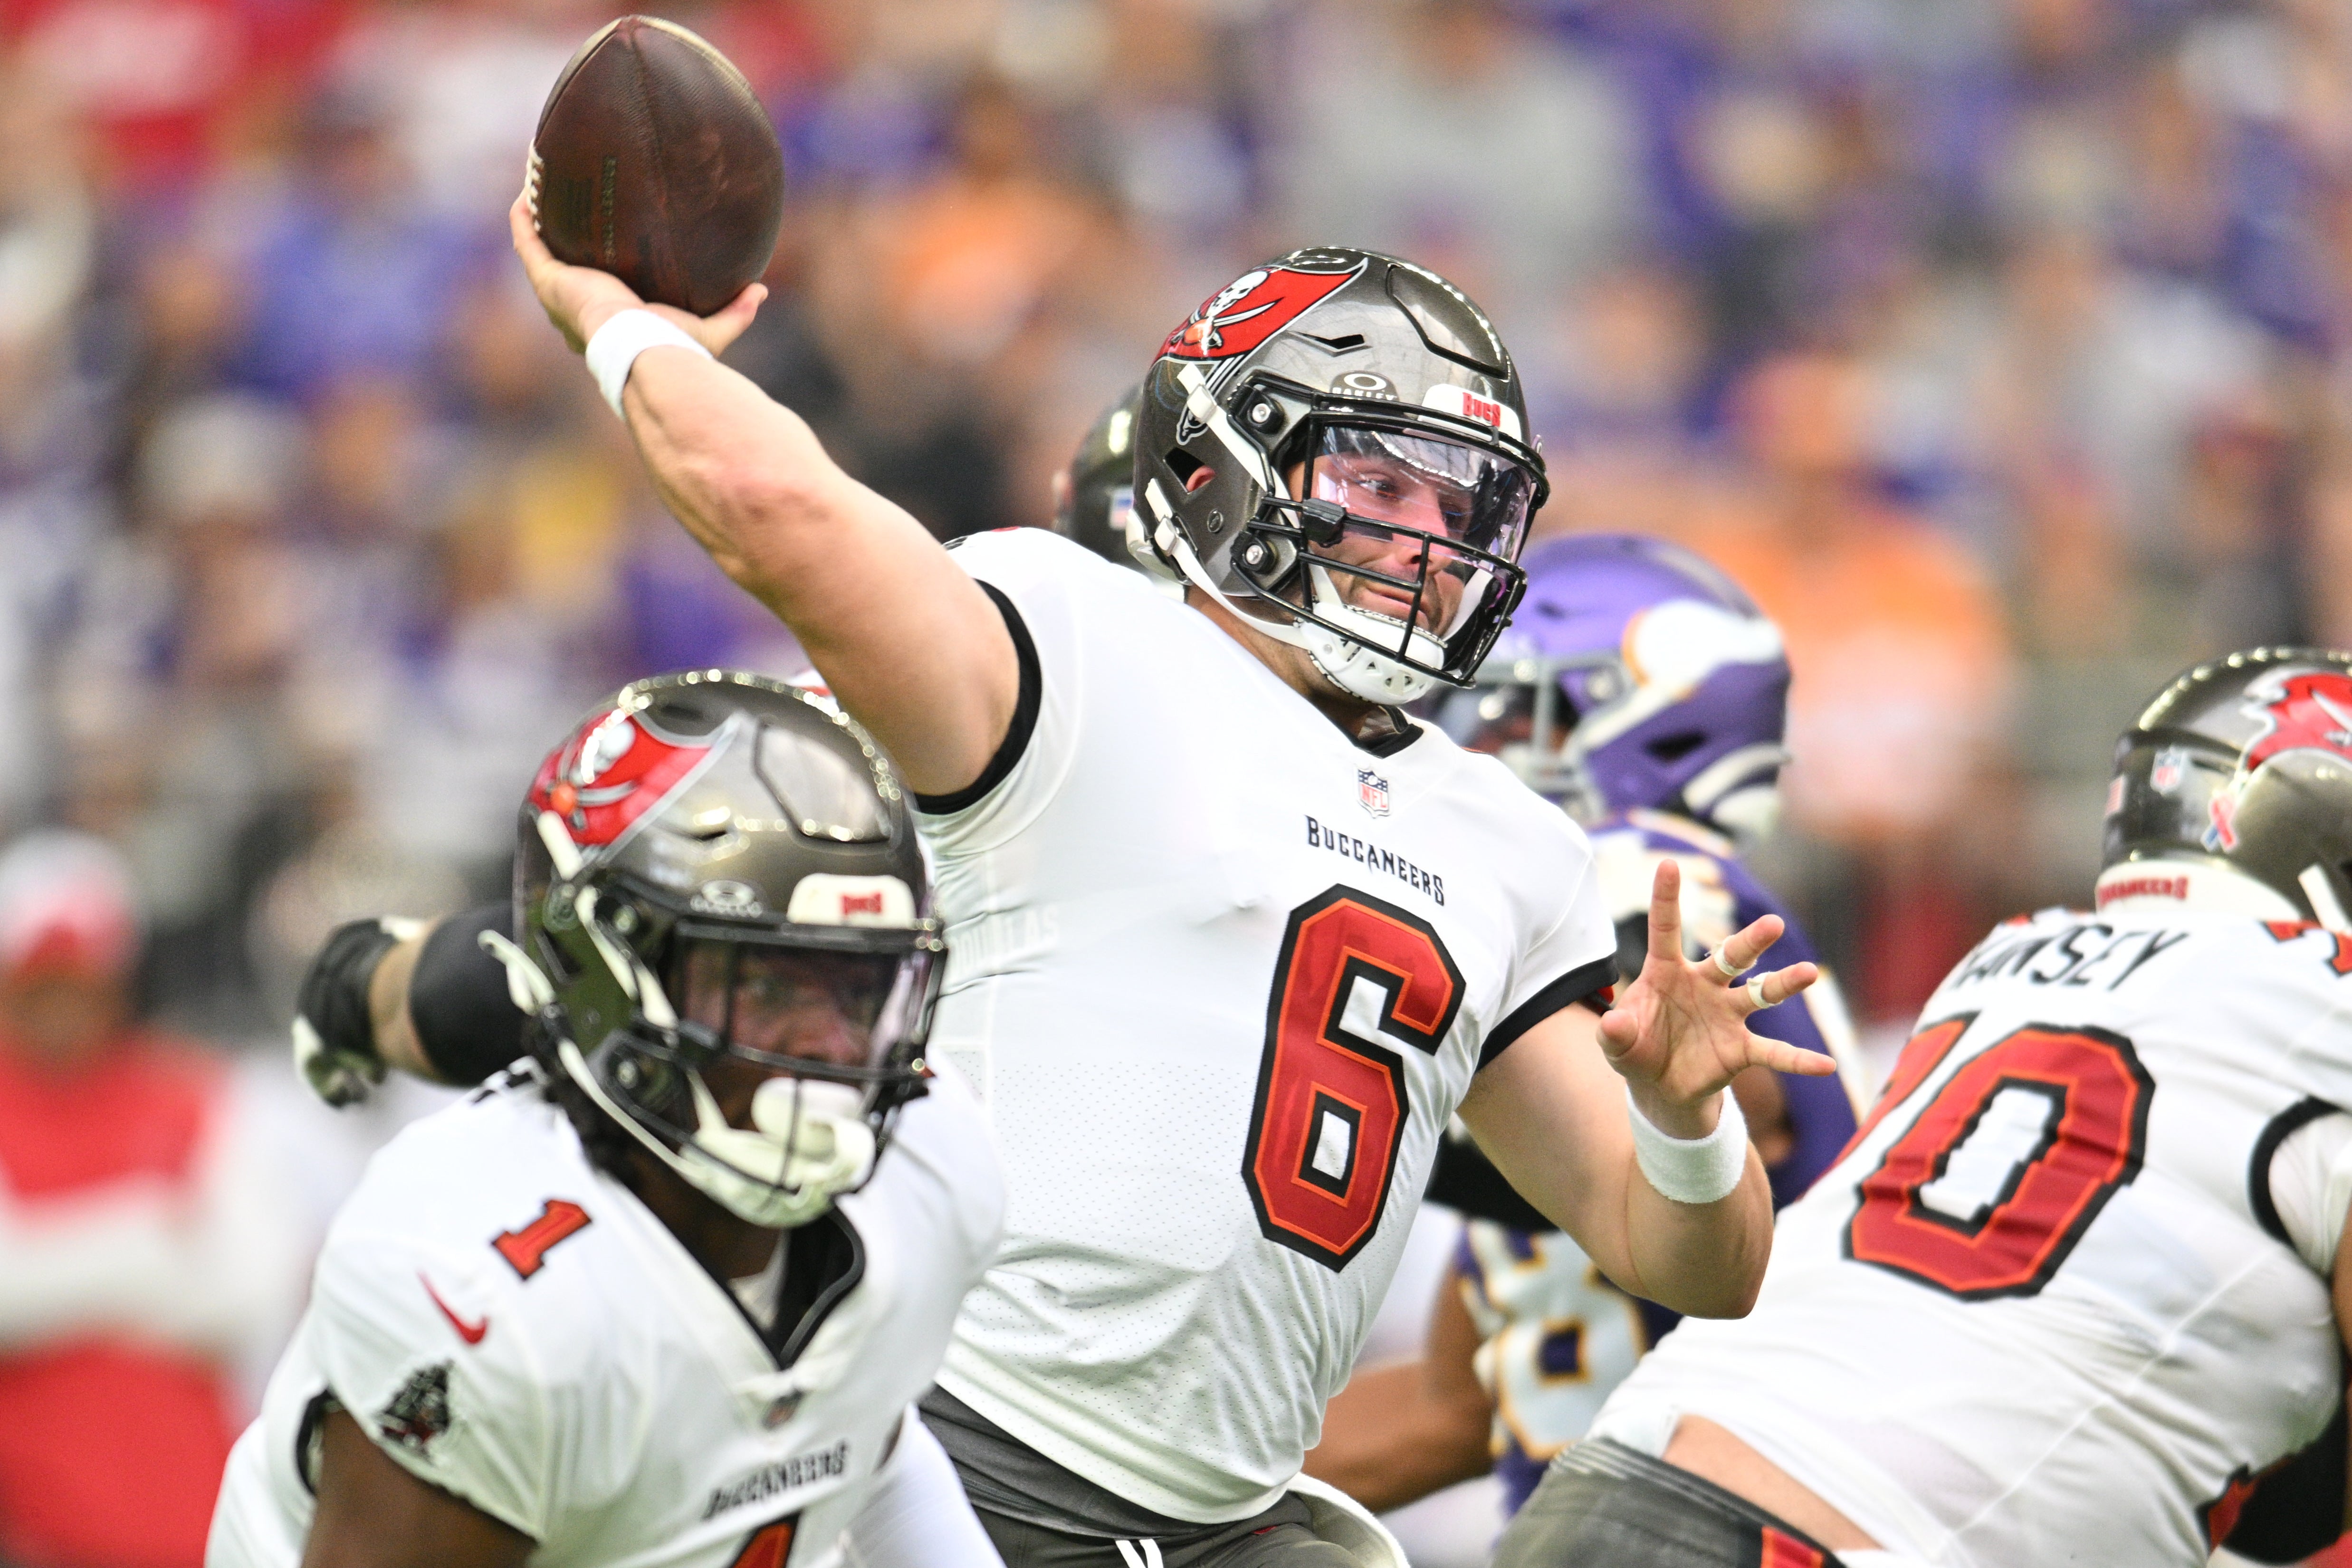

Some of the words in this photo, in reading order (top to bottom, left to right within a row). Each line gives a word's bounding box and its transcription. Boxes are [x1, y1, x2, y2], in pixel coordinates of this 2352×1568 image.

[1462, 392, 1501, 427] BUCS
[1361, 784, 1387, 808] NFL
[1304, 814, 1444, 907] BUCCANEERS
[1241, 883, 1466, 1273] 6
[491, 1199, 593, 1281] 1
